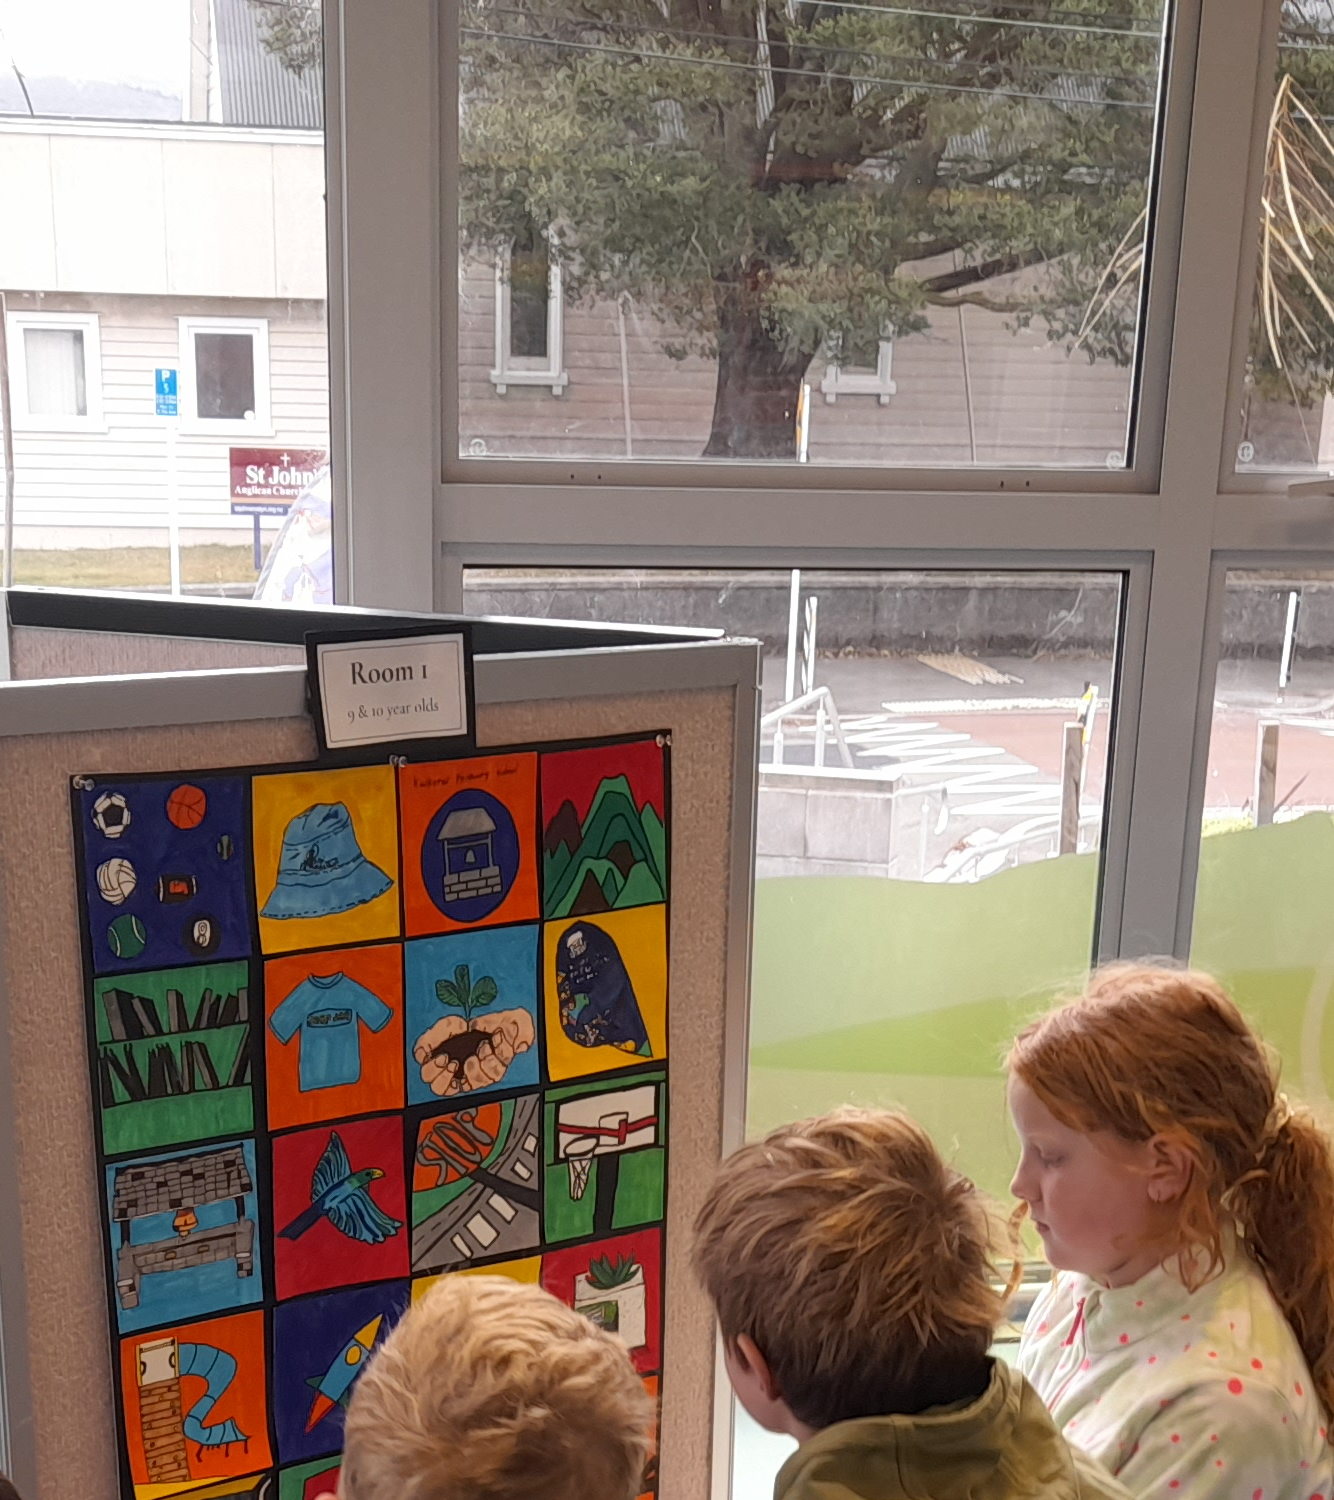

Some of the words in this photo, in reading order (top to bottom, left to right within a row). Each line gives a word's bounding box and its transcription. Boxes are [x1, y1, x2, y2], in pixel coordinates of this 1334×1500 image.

[161, 370, 171, 383] P
[245, 464, 266, 485] St
[268, 466, 318, 486] John'
[234, 485, 272, 496] Anglican
[350, 661, 414, 685] Room
[347, 710, 356, 725] 9
[358, 704, 368, 719] &
[372, 706, 384, 717] 10
[387, 704, 412, 721] year
[414, 697, 439, 713] olds
[416, 1107, 495, 1187] STOP
